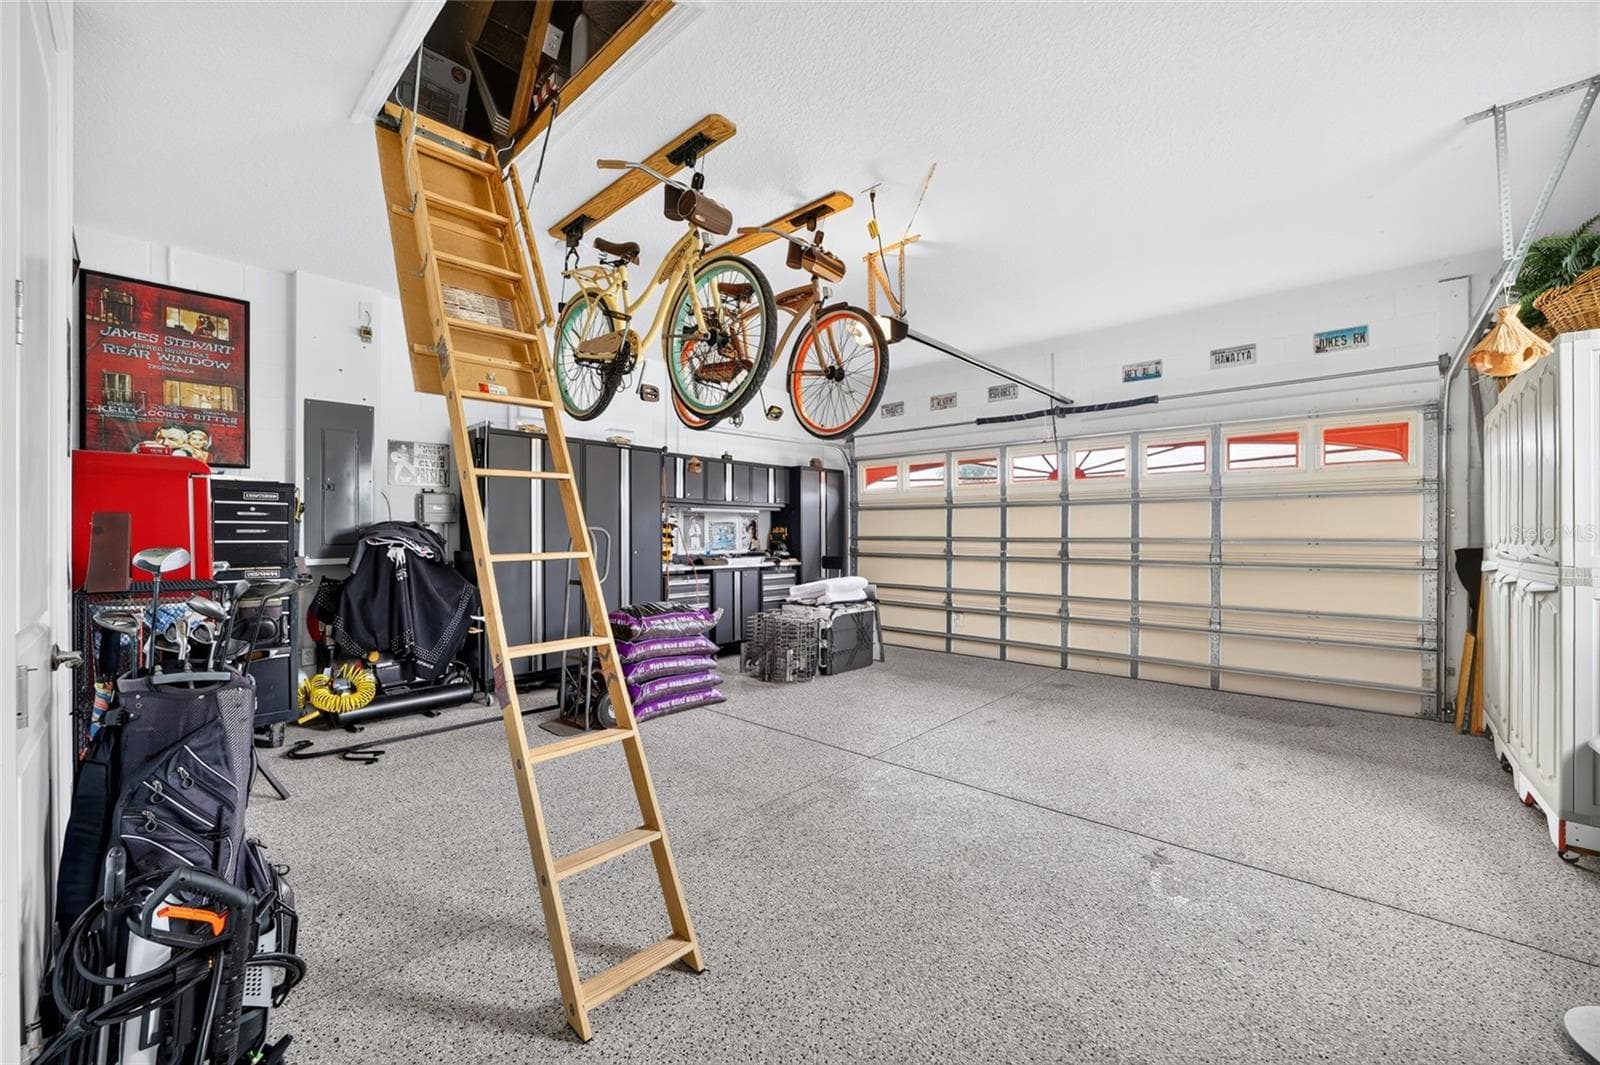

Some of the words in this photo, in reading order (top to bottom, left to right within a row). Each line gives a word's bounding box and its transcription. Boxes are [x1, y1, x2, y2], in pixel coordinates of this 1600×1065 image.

[101, 326, 159, 343] JAMES
[163, 335, 235, 355] STEWART
[102, 343, 151, 360] REAR
[157, 352, 232, 370] WINDOW
[98, 404, 142, 415] KELLY
